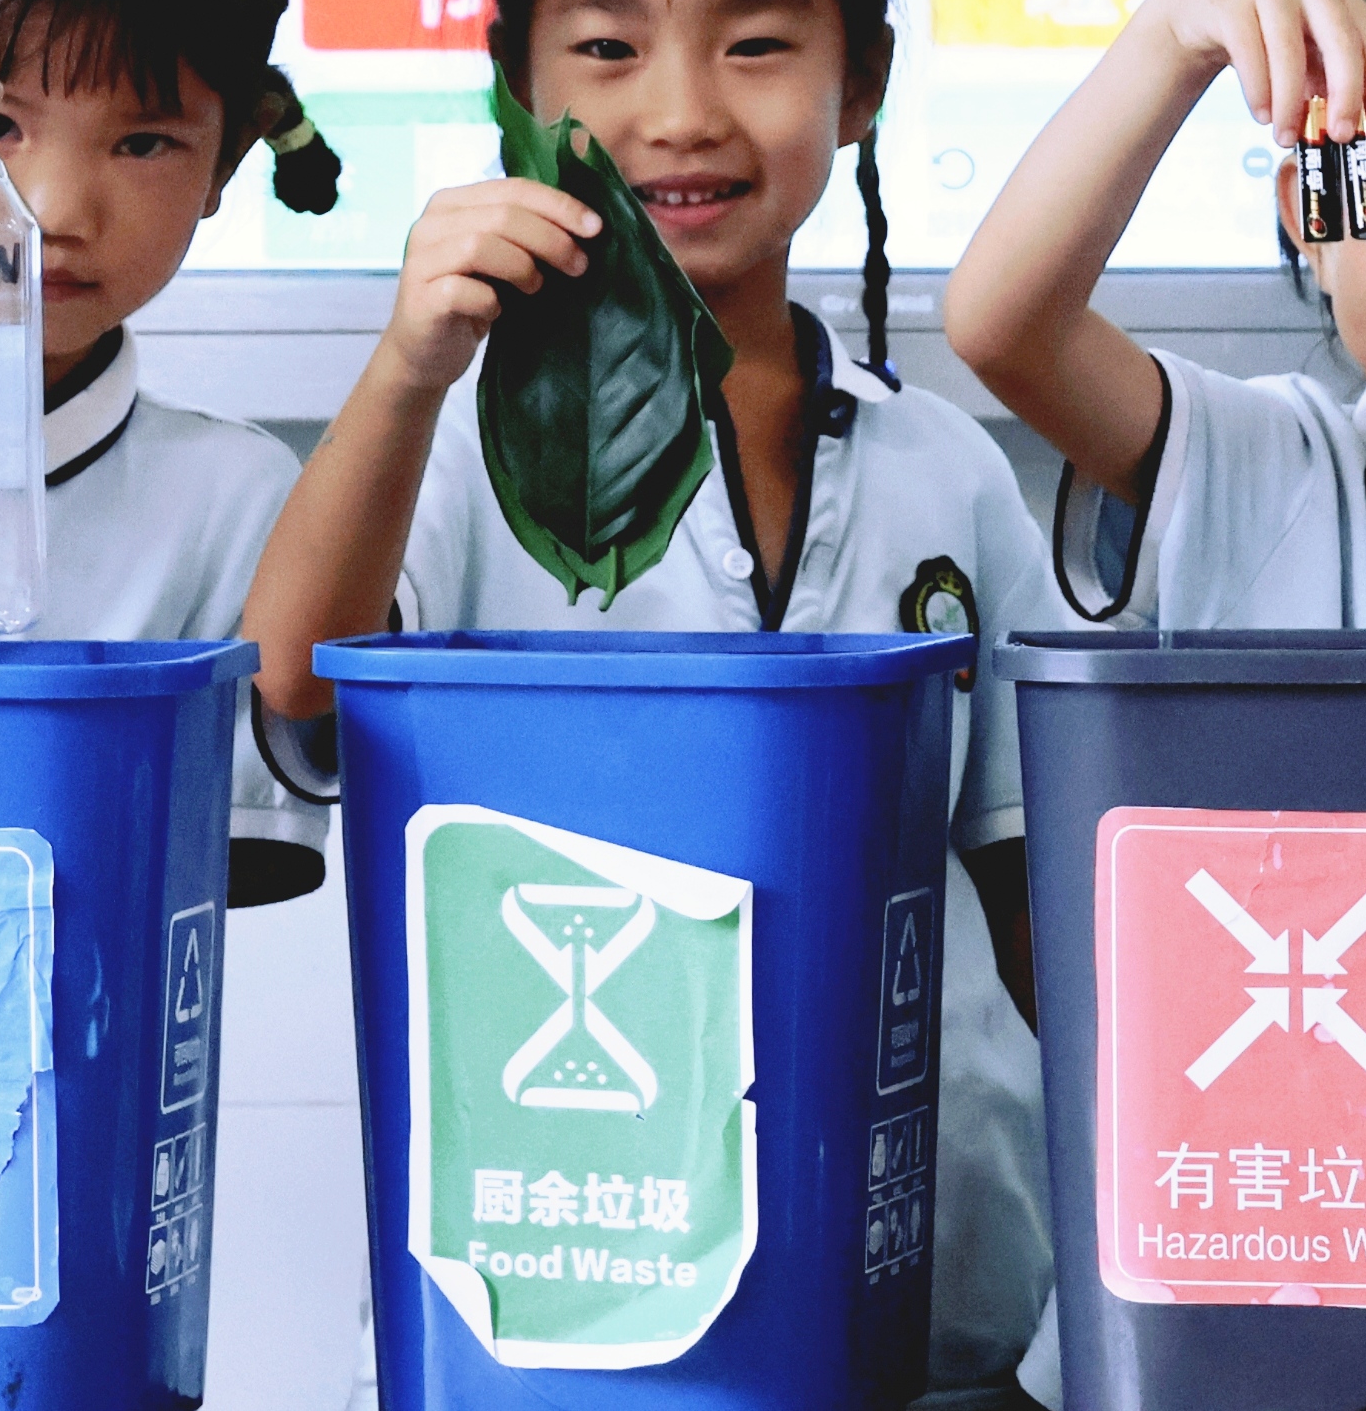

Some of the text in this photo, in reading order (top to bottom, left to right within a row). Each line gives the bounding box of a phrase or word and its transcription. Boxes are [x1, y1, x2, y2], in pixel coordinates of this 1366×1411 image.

[472, 1168, 691, 1234] 厨余垃圾
[468, 1240, 698, 1288] Food Waste
[1138, 1223, 1332, 1264] Hazardous
